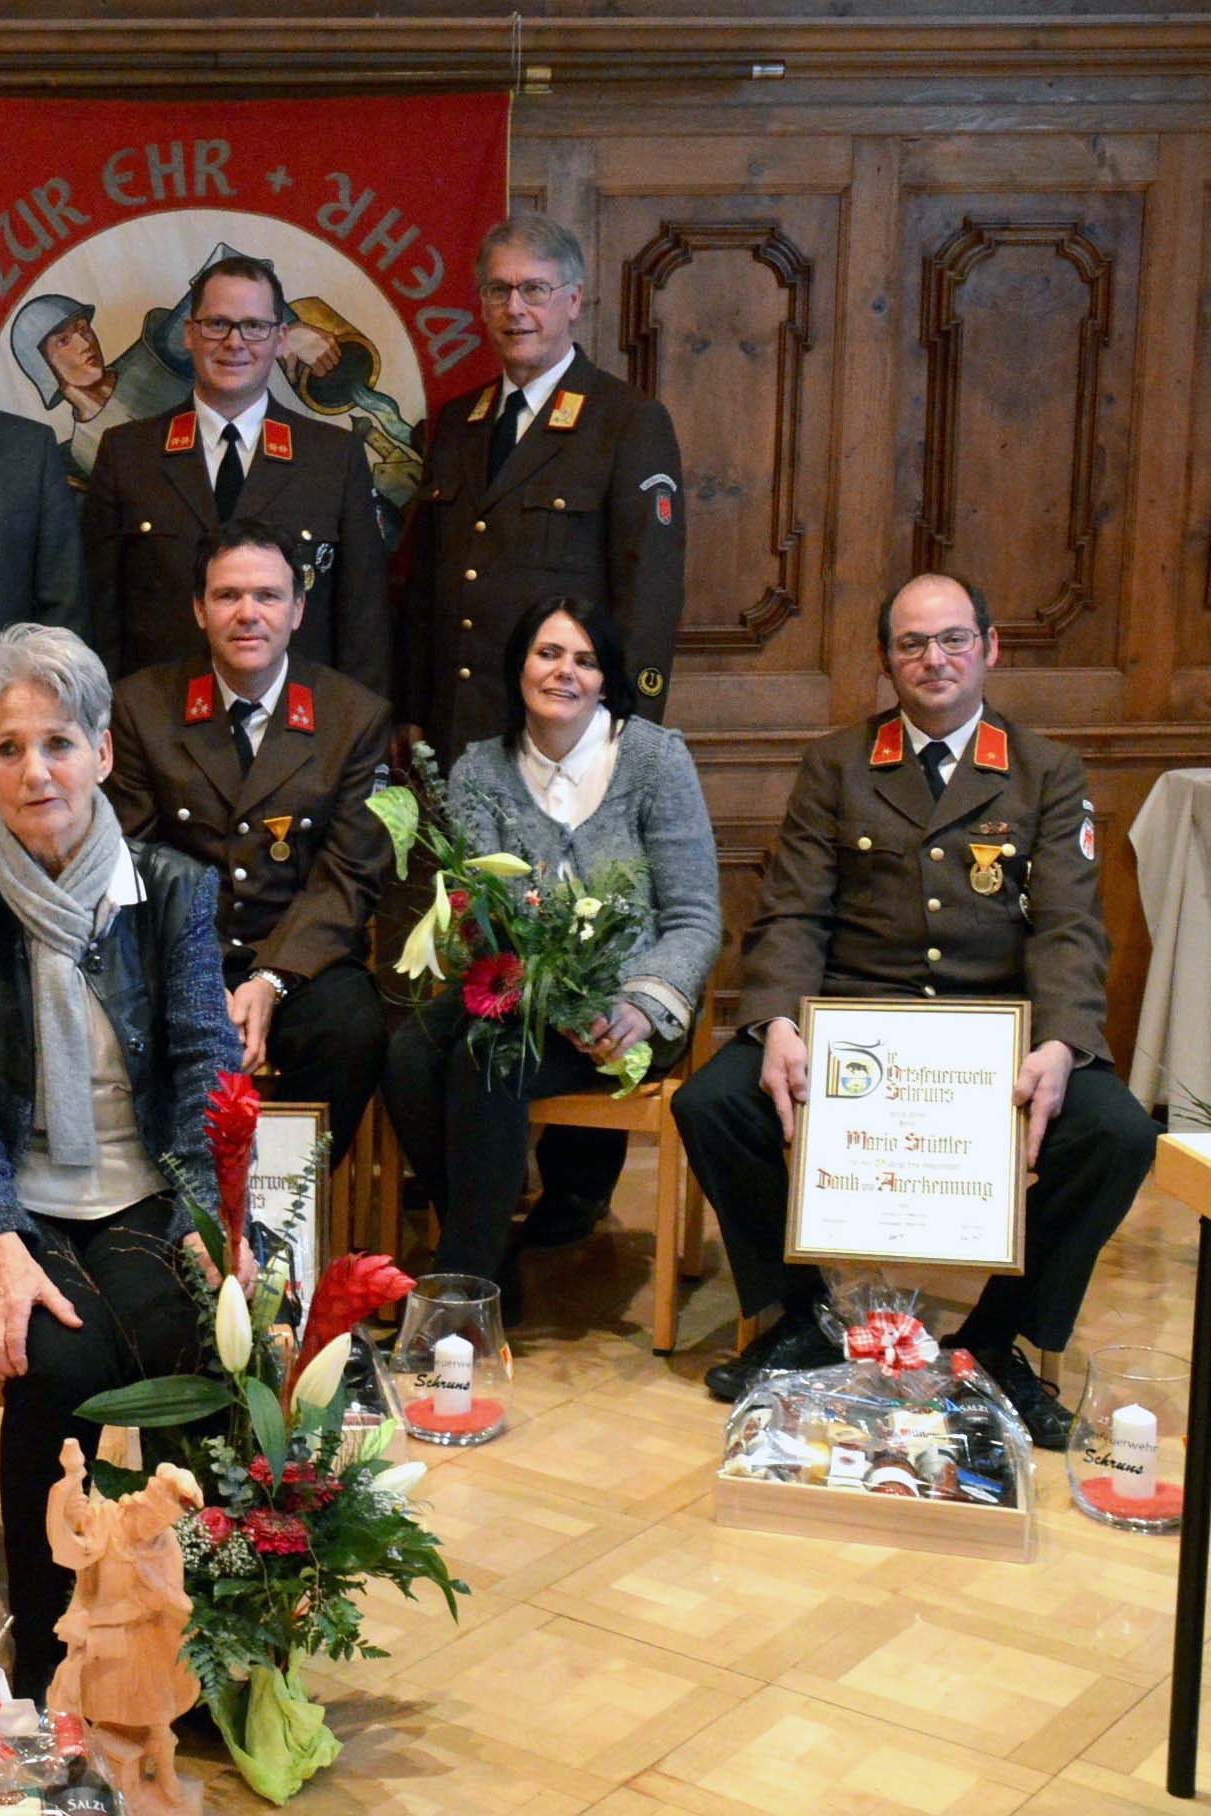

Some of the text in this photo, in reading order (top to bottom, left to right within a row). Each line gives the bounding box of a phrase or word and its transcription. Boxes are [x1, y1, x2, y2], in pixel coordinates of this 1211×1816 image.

[101, 138, 237, 206] EHR
[316, 171, 481, 377] WEHR
[886, 1063, 996, 1085] Ortsfeuerwehr
[886, 1083, 956, 1104] Schruns
[414, 1373, 471, 1391] Schruns
[1083, 1448, 1144, 1475] Schruns
